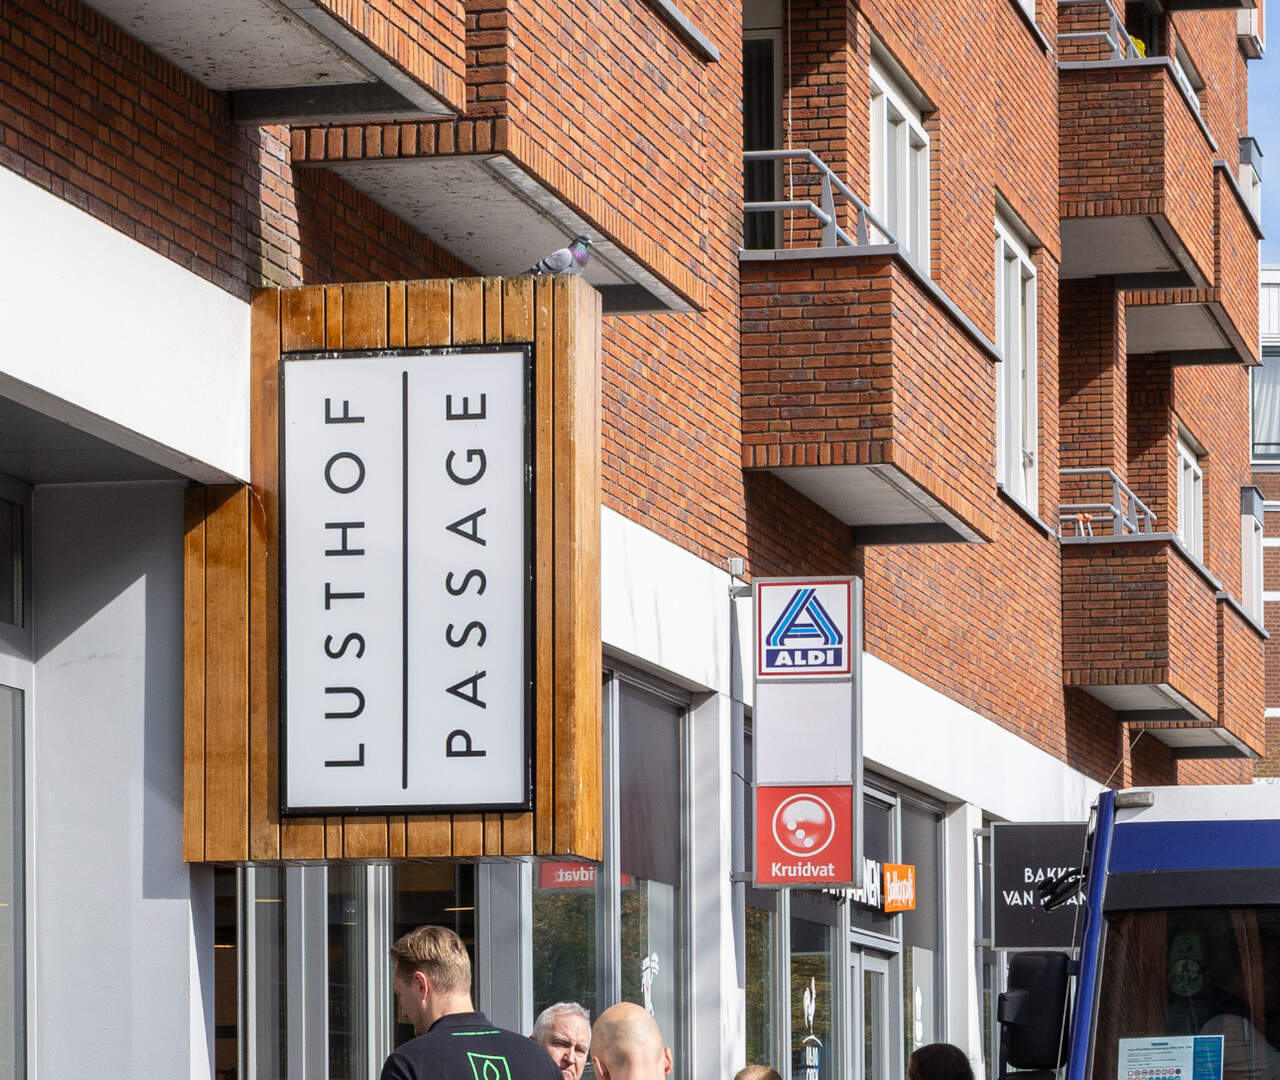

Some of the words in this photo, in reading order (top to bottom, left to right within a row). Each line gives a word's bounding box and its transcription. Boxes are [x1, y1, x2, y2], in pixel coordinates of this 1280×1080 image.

[324, 398, 366, 768] LUSTHOF
[445, 393, 487, 758] PASSAGE
[774, 649, 835, 666] ALDI
[771, 862, 836, 877] Kruidvat
[1003, 890, 1034, 906] VAN
